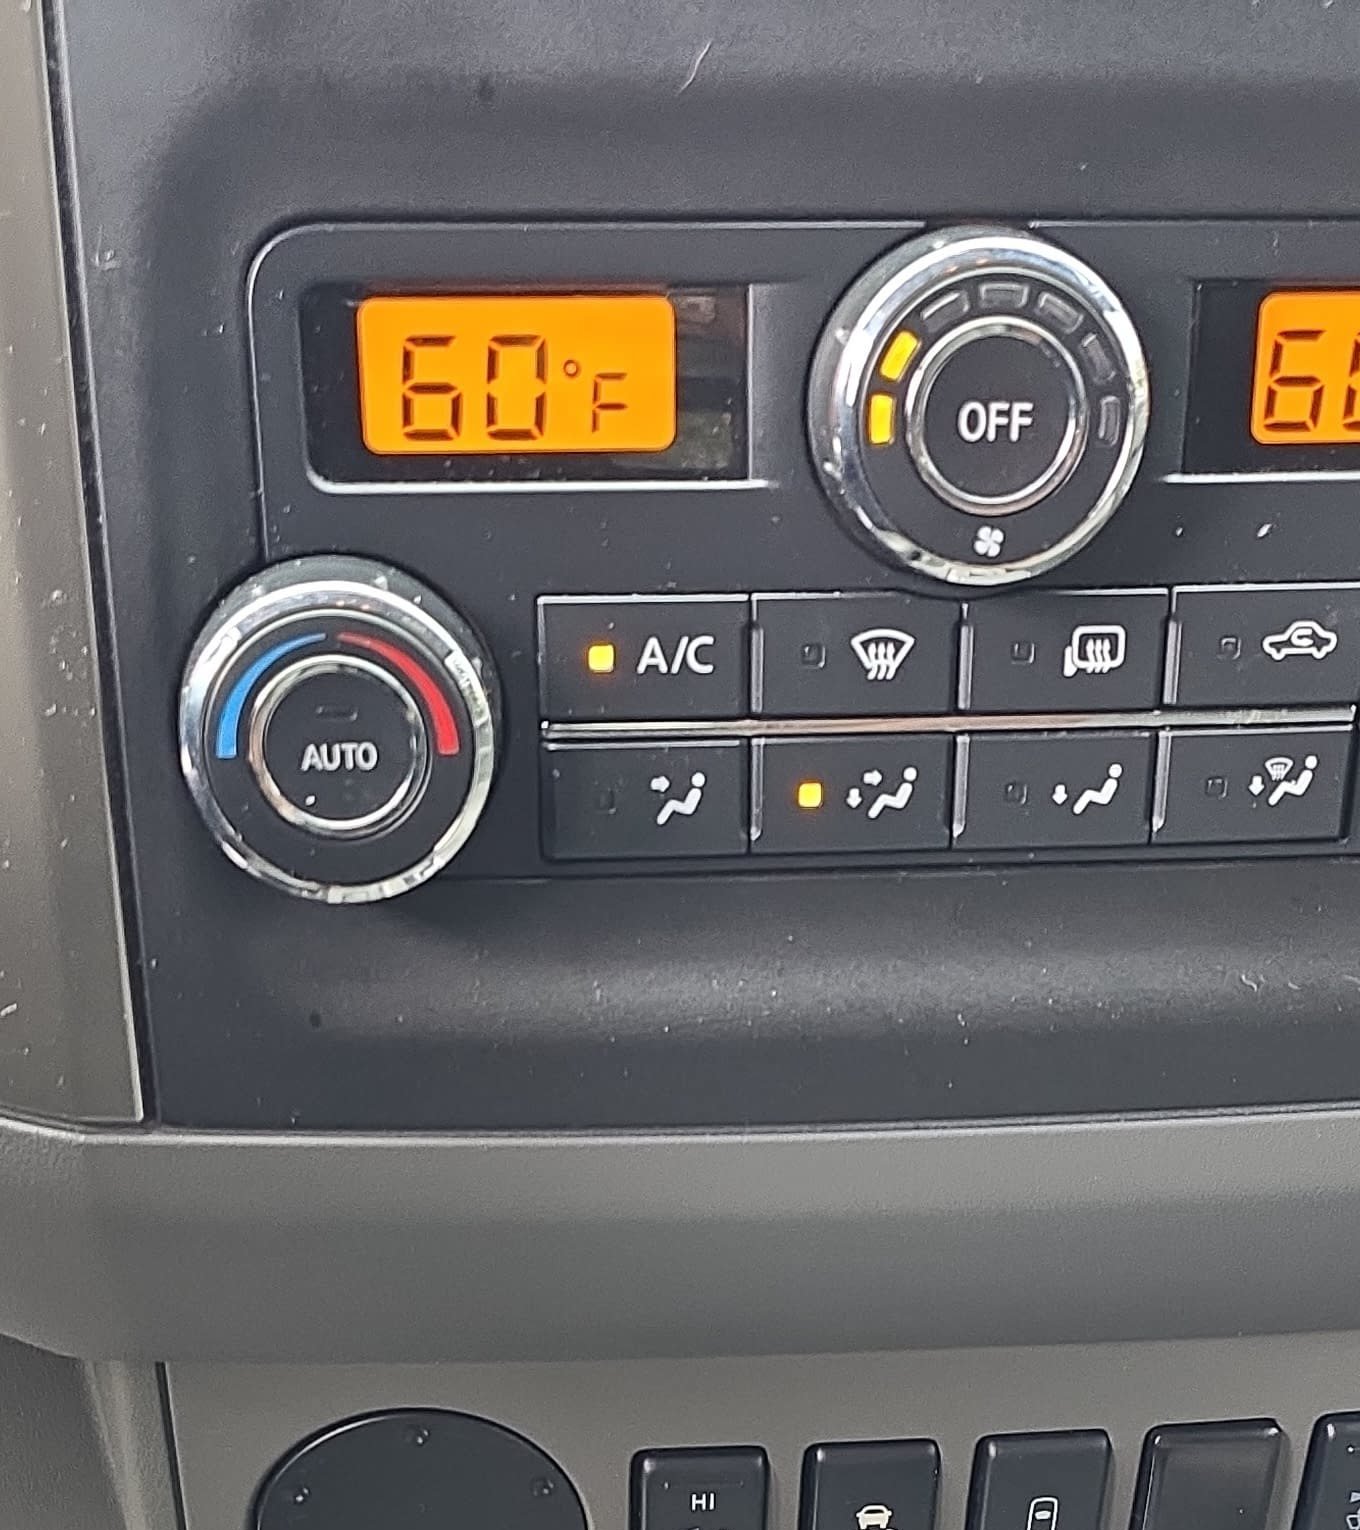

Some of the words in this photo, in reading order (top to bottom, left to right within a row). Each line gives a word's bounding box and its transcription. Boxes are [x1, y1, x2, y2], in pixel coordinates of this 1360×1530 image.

[956, 400, 1035, 444] OFF
[635, 631, 717, 676] A/C
[300, 740, 380, 772] AUTO
[690, 1491, 716, 1513] HI
